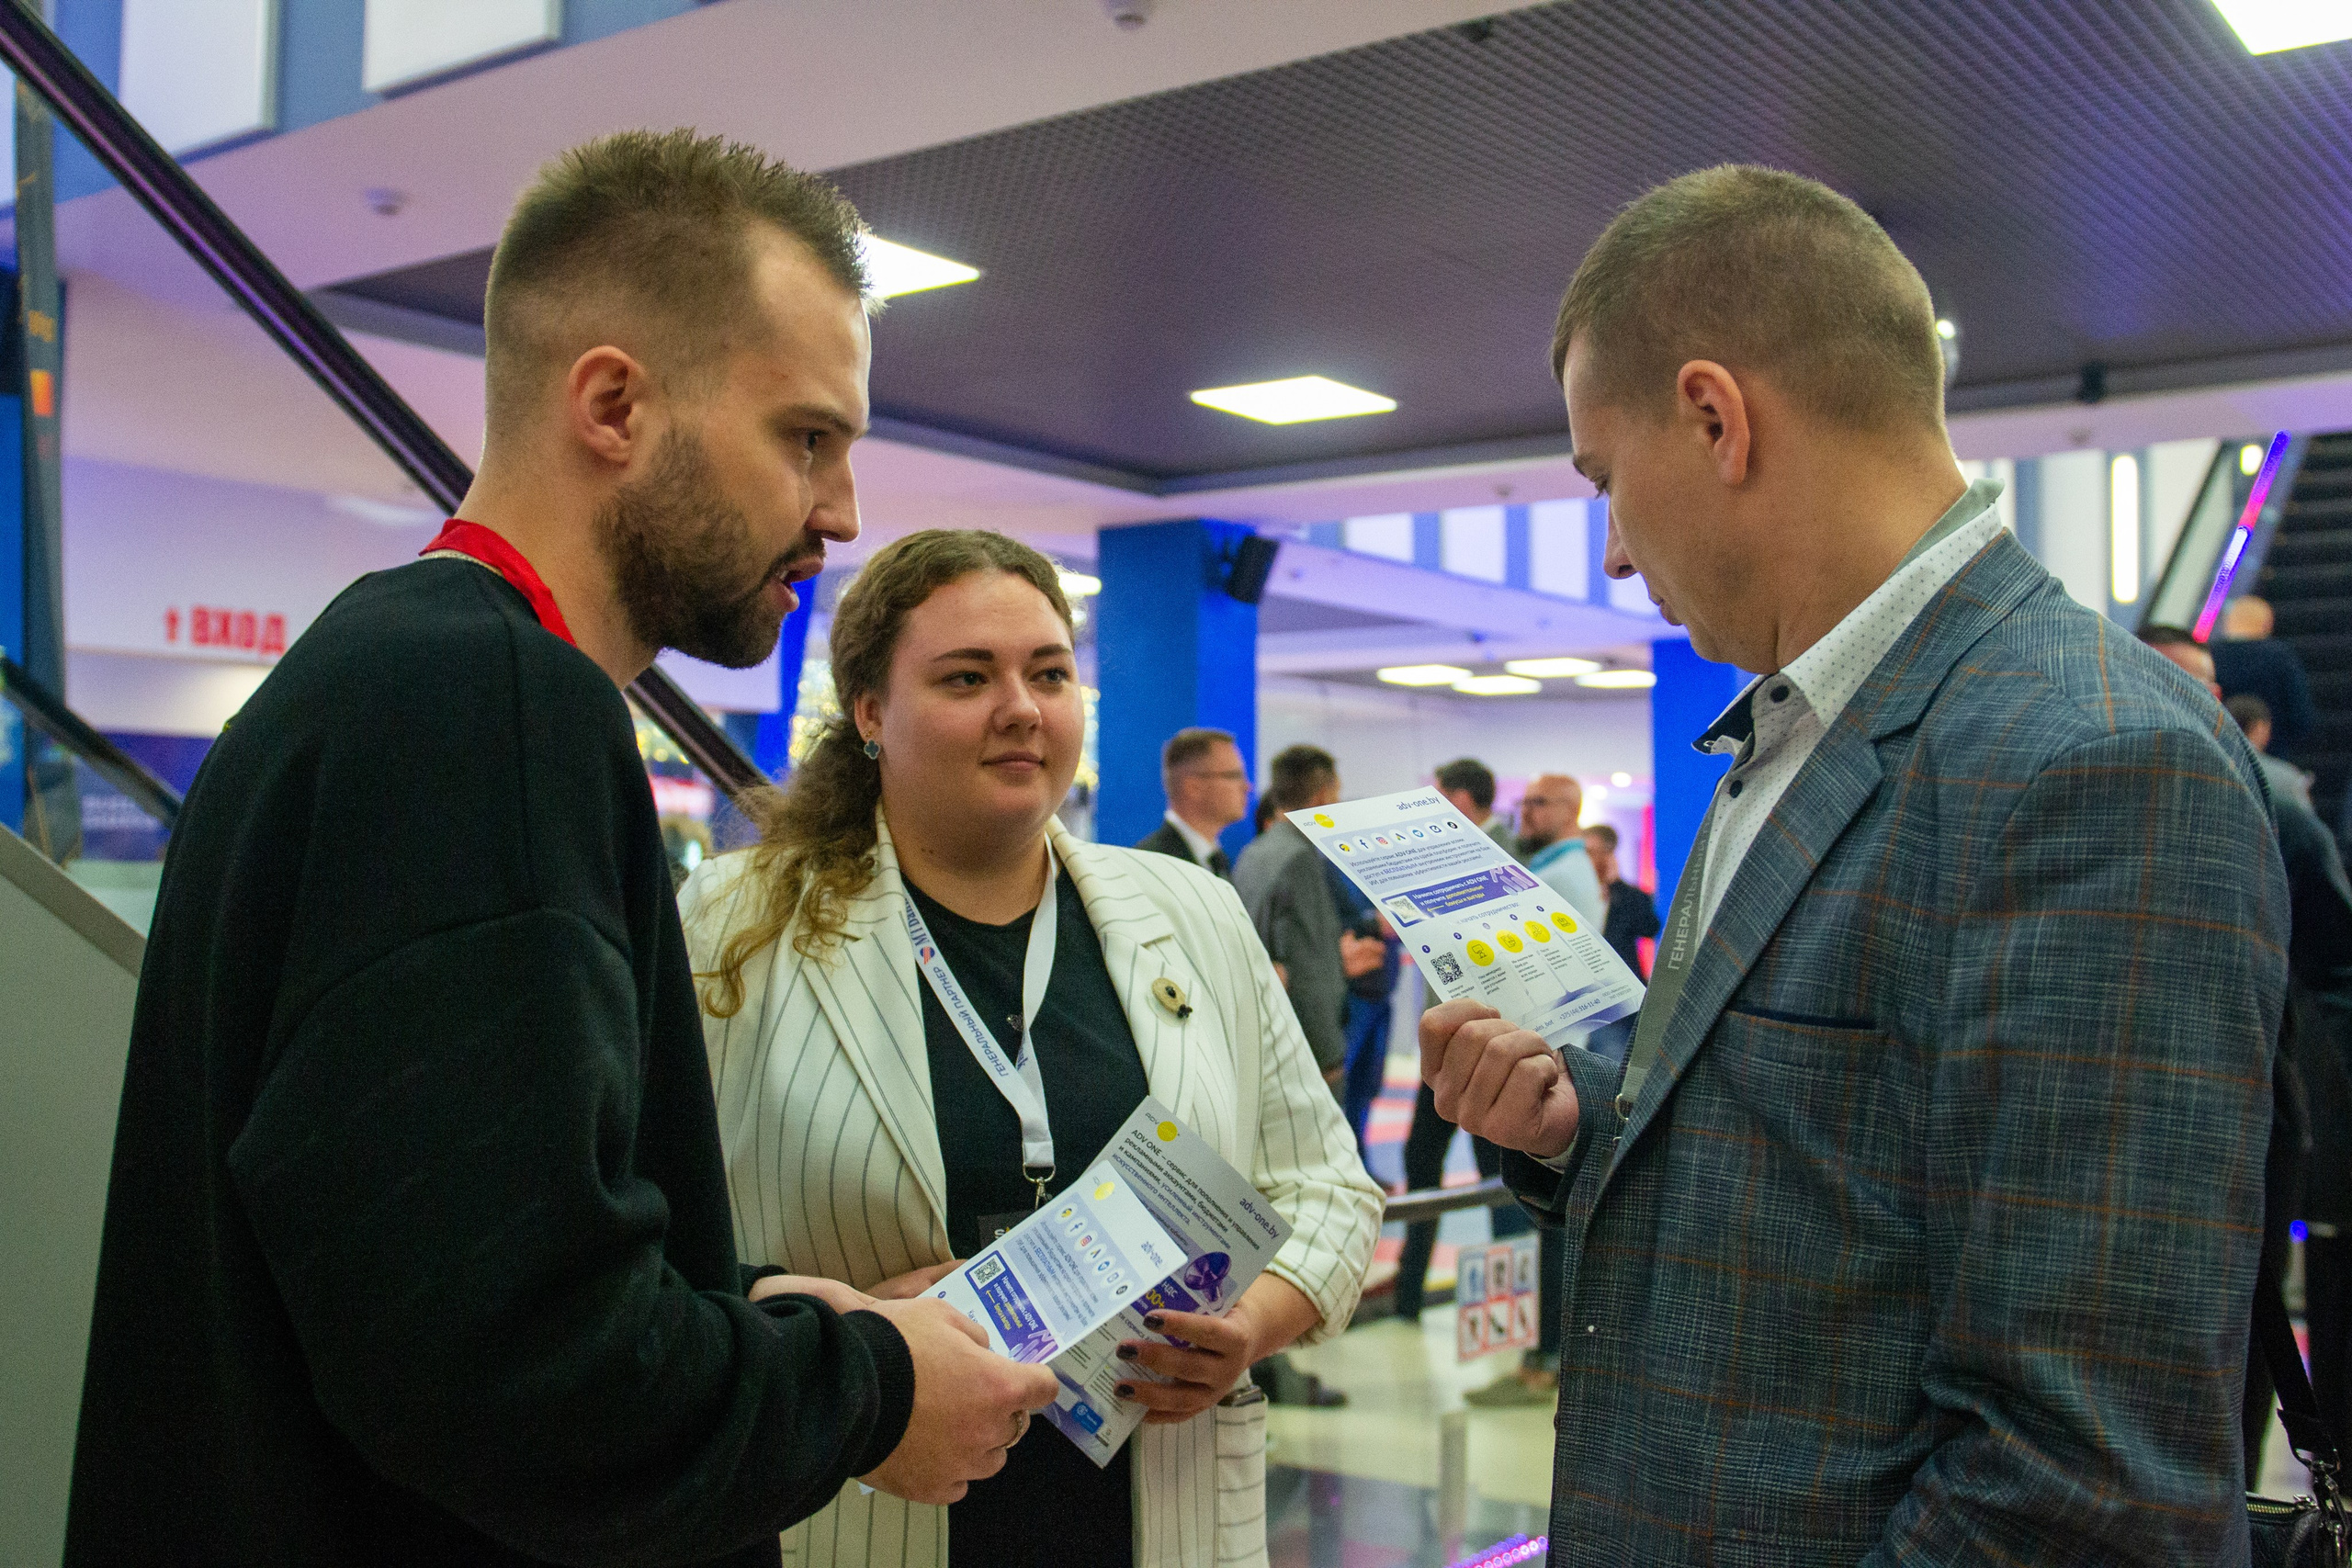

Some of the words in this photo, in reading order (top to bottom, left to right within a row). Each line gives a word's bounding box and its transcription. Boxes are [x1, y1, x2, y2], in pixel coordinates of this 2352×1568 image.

[191, 605, 286, 658] ВХОД
[1396, 797, 1440, 810] adv-one.by
[933, 966, 964, 1009] ПАРТНЕР
[958, 1010, 1009, 1077] ГЕНЕРАЛЬНЫЙ
[1113, 1154, 1158, 1194] искусственного
[1158, 1193, 1190, 1225] интеллекта.
[1125, 1138, 1163, 1172] рекламными
[1163, 1171, 1196, 1203] аккаунтами,
[1198, 1201, 1227, 1233] бюджетами
[1125, 1150, 1160, 1185] кампаниями,
[1161, 1183, 1193, 1213] усиленный
[1192, 1212, 1231, 1249] инструментами
[1132, 1130, 1148, 1143] ADV
[1147, 1142, 1161, 1156] ONE
[1167, 1160, 1187, 1179] сервис
[1185, 1179, 1198, 1189] для
[1198, 1189, 1229, 1219] пополнения
[1239, 1198, 1279, 1239] adv-one.by
[1161, 1280, 1178, 1298] НДС
